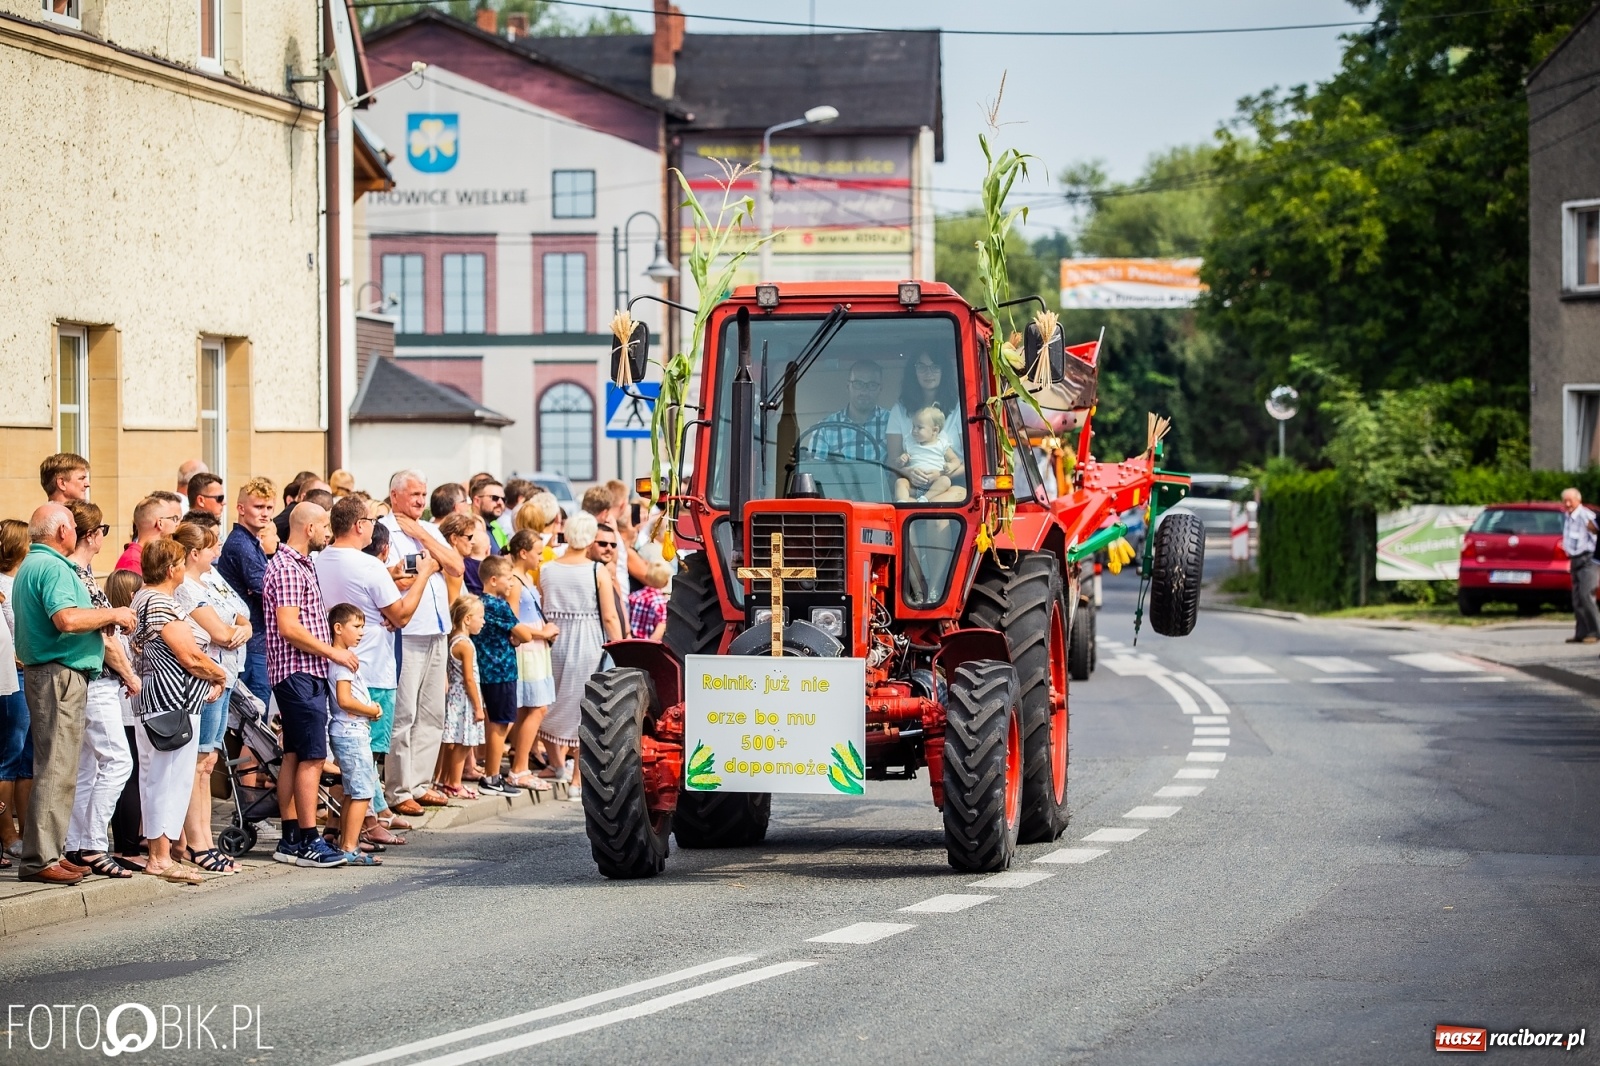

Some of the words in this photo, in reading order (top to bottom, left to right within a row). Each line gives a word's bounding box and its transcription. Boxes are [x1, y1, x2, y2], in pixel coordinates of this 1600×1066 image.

[456, 189, 527, 205] WIELKIE
[763, 674, 790, 694] już
[801, 676, 830, 692] nie
[707, 711, 747, 724] orze
[754, 709, 779, 725] bo
[787, 713, 816, 725] mu
[741, 735, 787, 751] 500+
[724, 757, 828, 777] dopomoże
